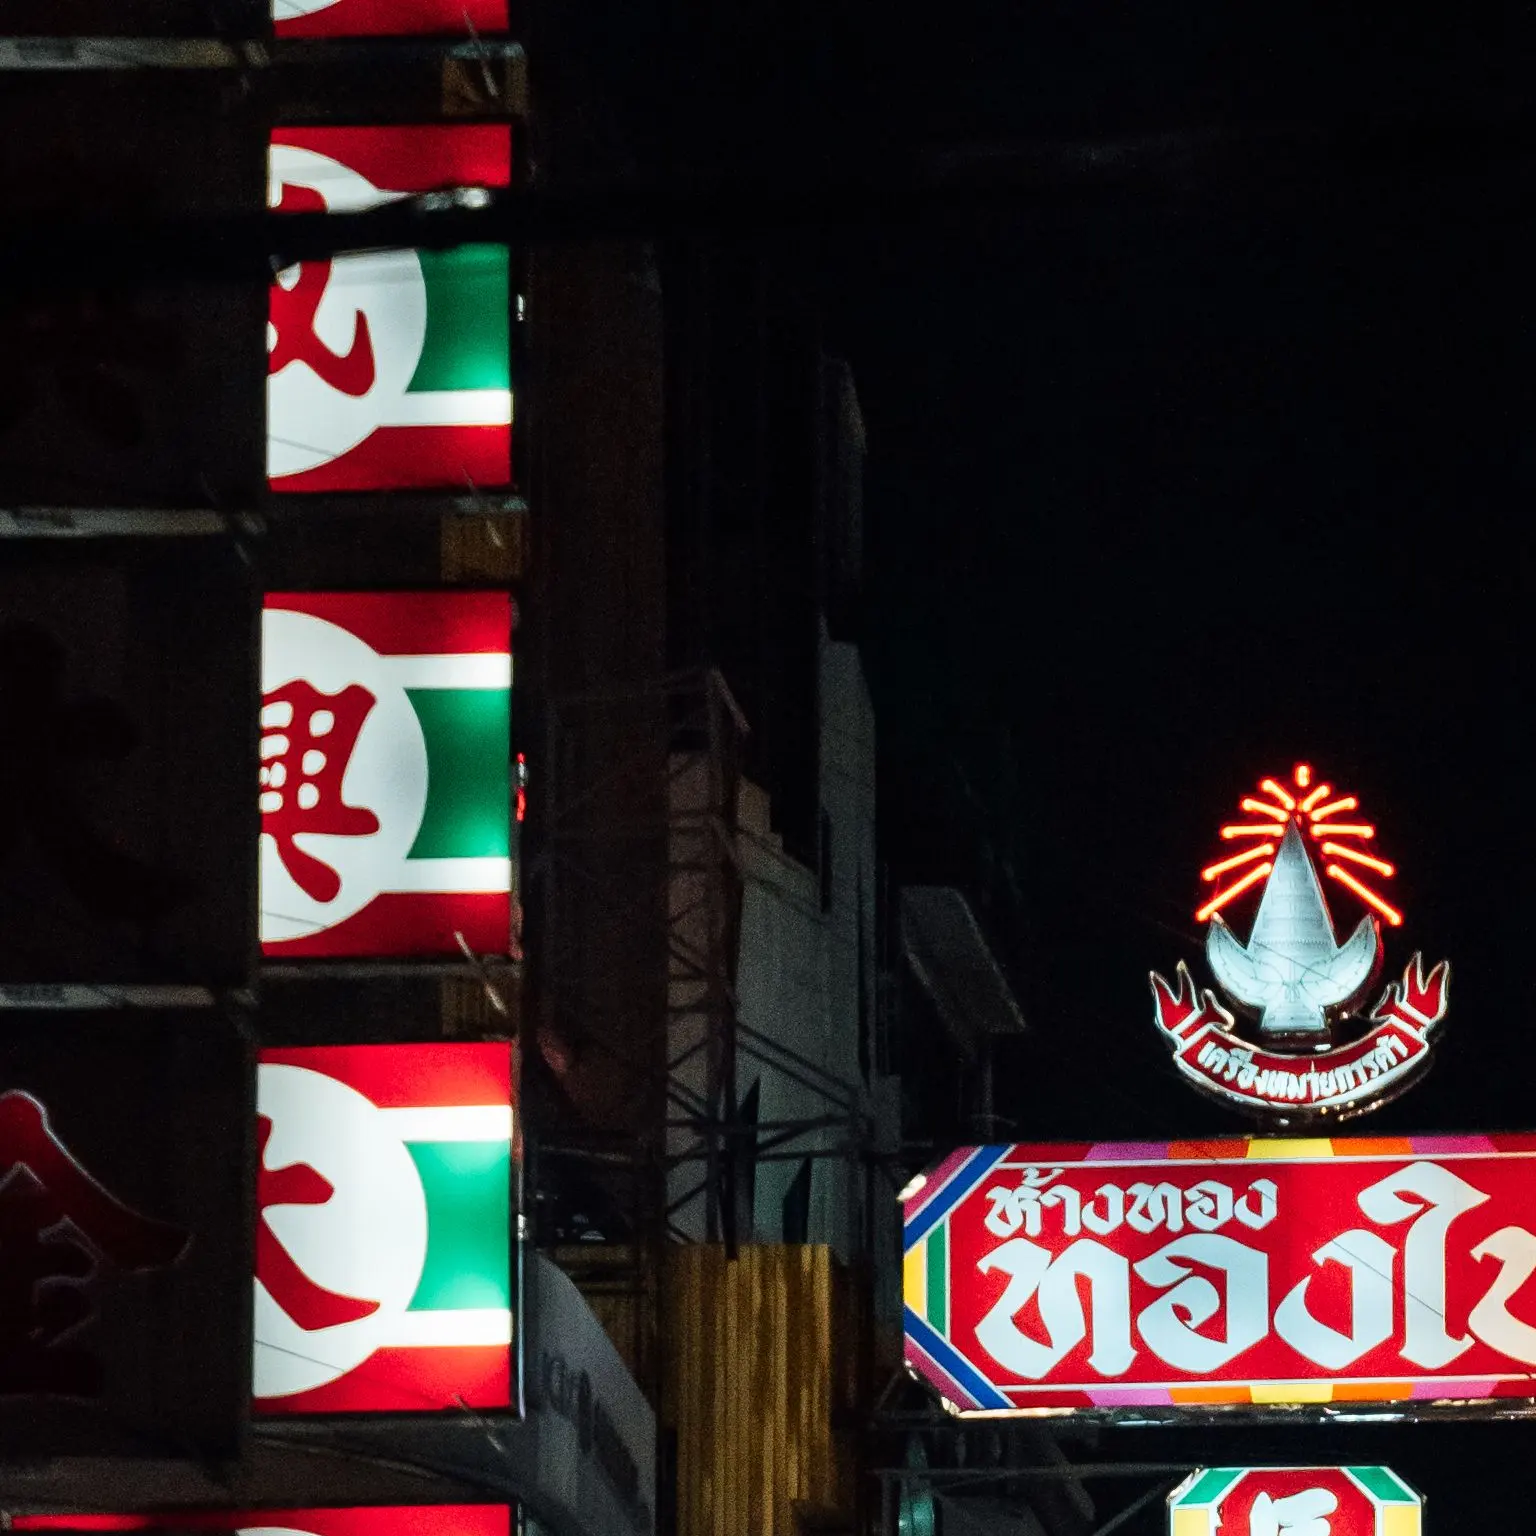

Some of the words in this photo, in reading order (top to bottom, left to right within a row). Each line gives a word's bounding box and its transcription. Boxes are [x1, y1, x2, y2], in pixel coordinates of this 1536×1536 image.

[1197, 1034, 1409, 1102] เครื่องหมายการค้า
[984, 1168, 1278, 1237] ห้างทอง
